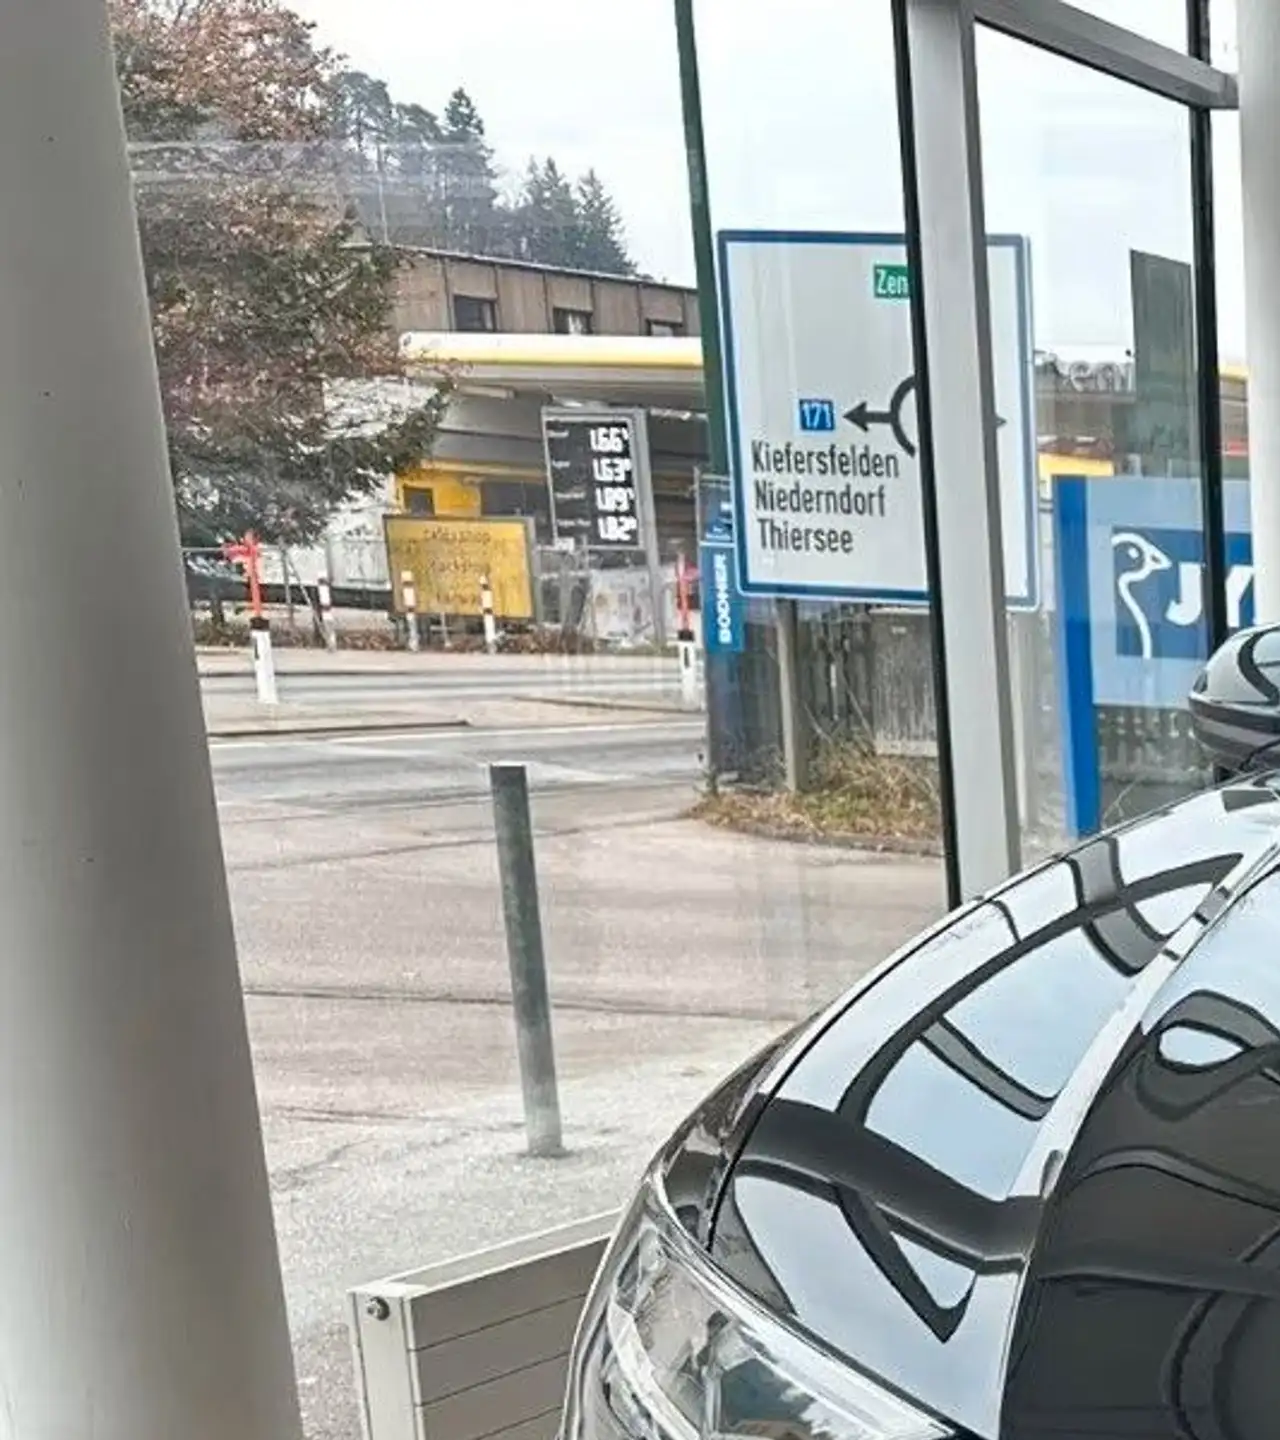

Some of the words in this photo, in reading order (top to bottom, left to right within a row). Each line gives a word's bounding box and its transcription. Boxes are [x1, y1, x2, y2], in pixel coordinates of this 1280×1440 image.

[876, 268, 909, 295] Zen
[802, 402, 832, 428] 171
[751, 440, 900, 478] Kiefersfelden
[754, 479, 886, 517] Niederndorf
[757, 518, 854, 554] Thiersee
